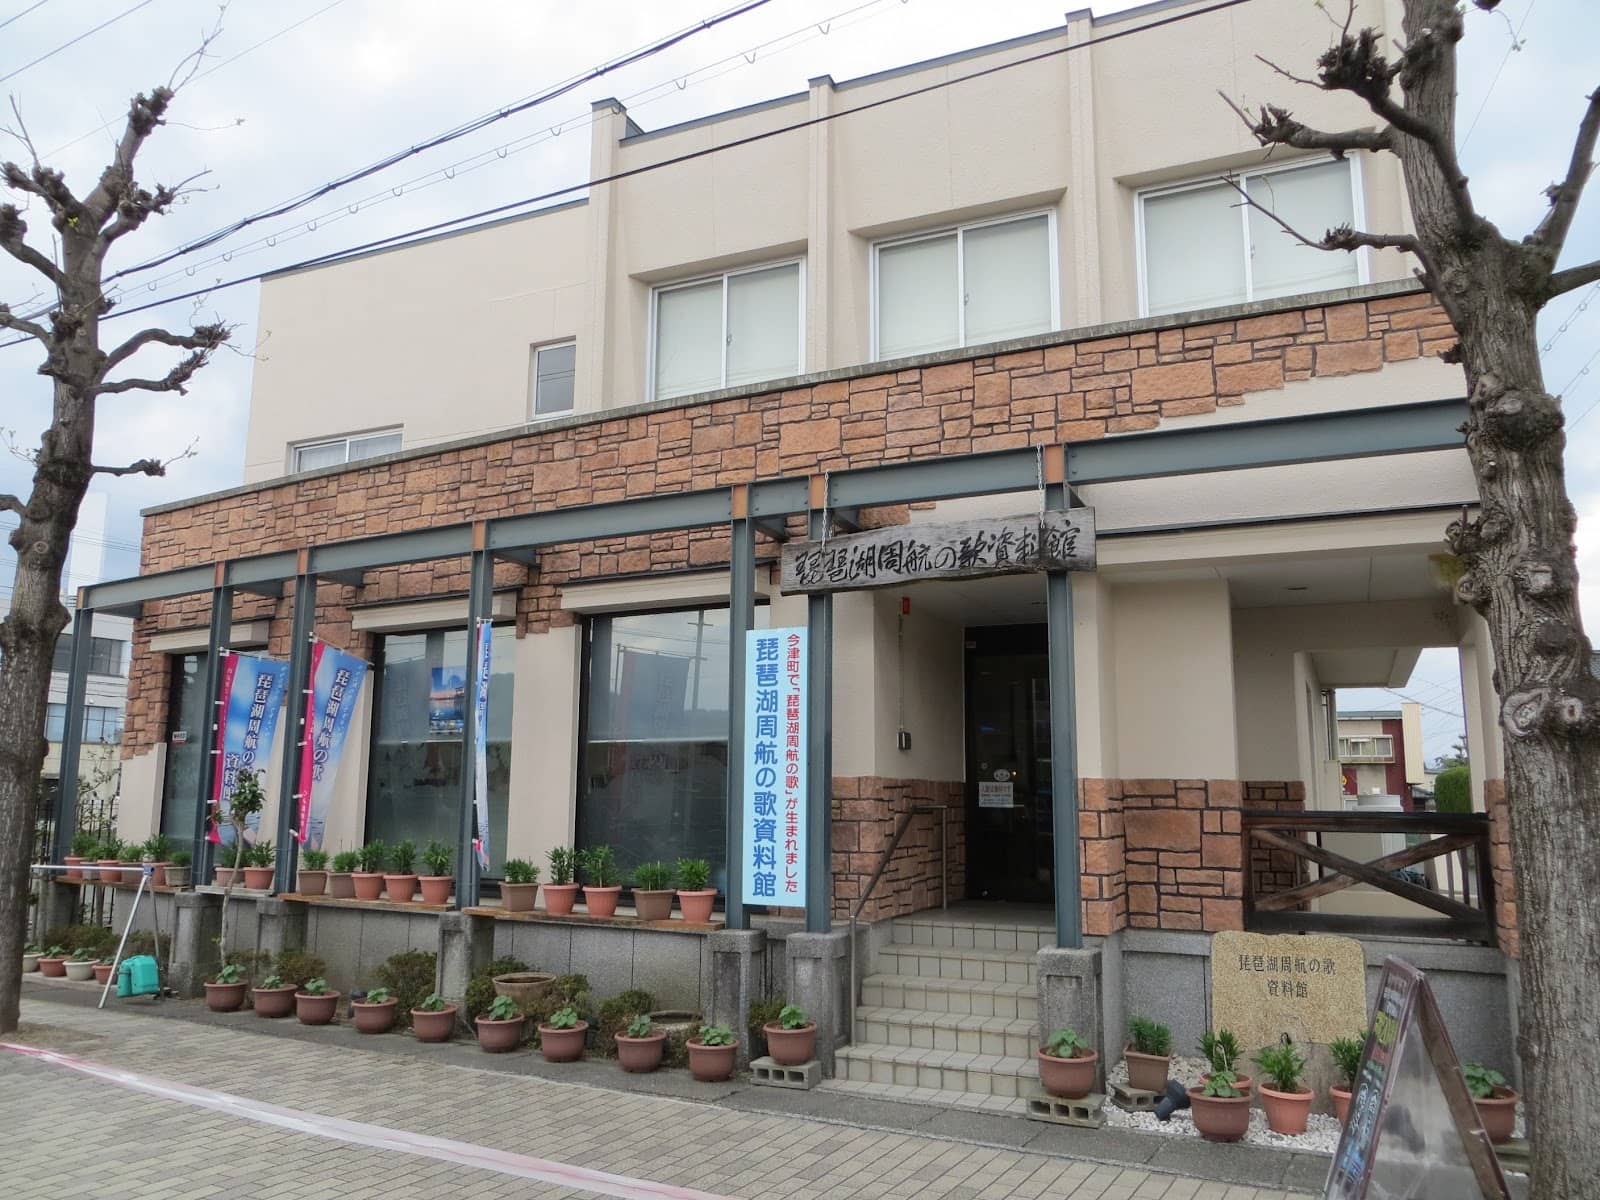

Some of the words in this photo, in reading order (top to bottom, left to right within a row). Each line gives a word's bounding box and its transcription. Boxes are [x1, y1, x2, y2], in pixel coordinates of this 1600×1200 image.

[795, 520, 1081, 585] 琵琶湖周航の歌資料館
[243, 674, 273, 771] 琵琶湖周航の
[785, 633, 800, 893] 今津町で「琵琶湖周航の歌」が生まれました
[752, 637, 779, 897] 琵琶湖周航の歌資料館
[1238, 954, 1336, 975] 琵琶湖周航の歌
[1267, 979, 1309, 998] 資料館
